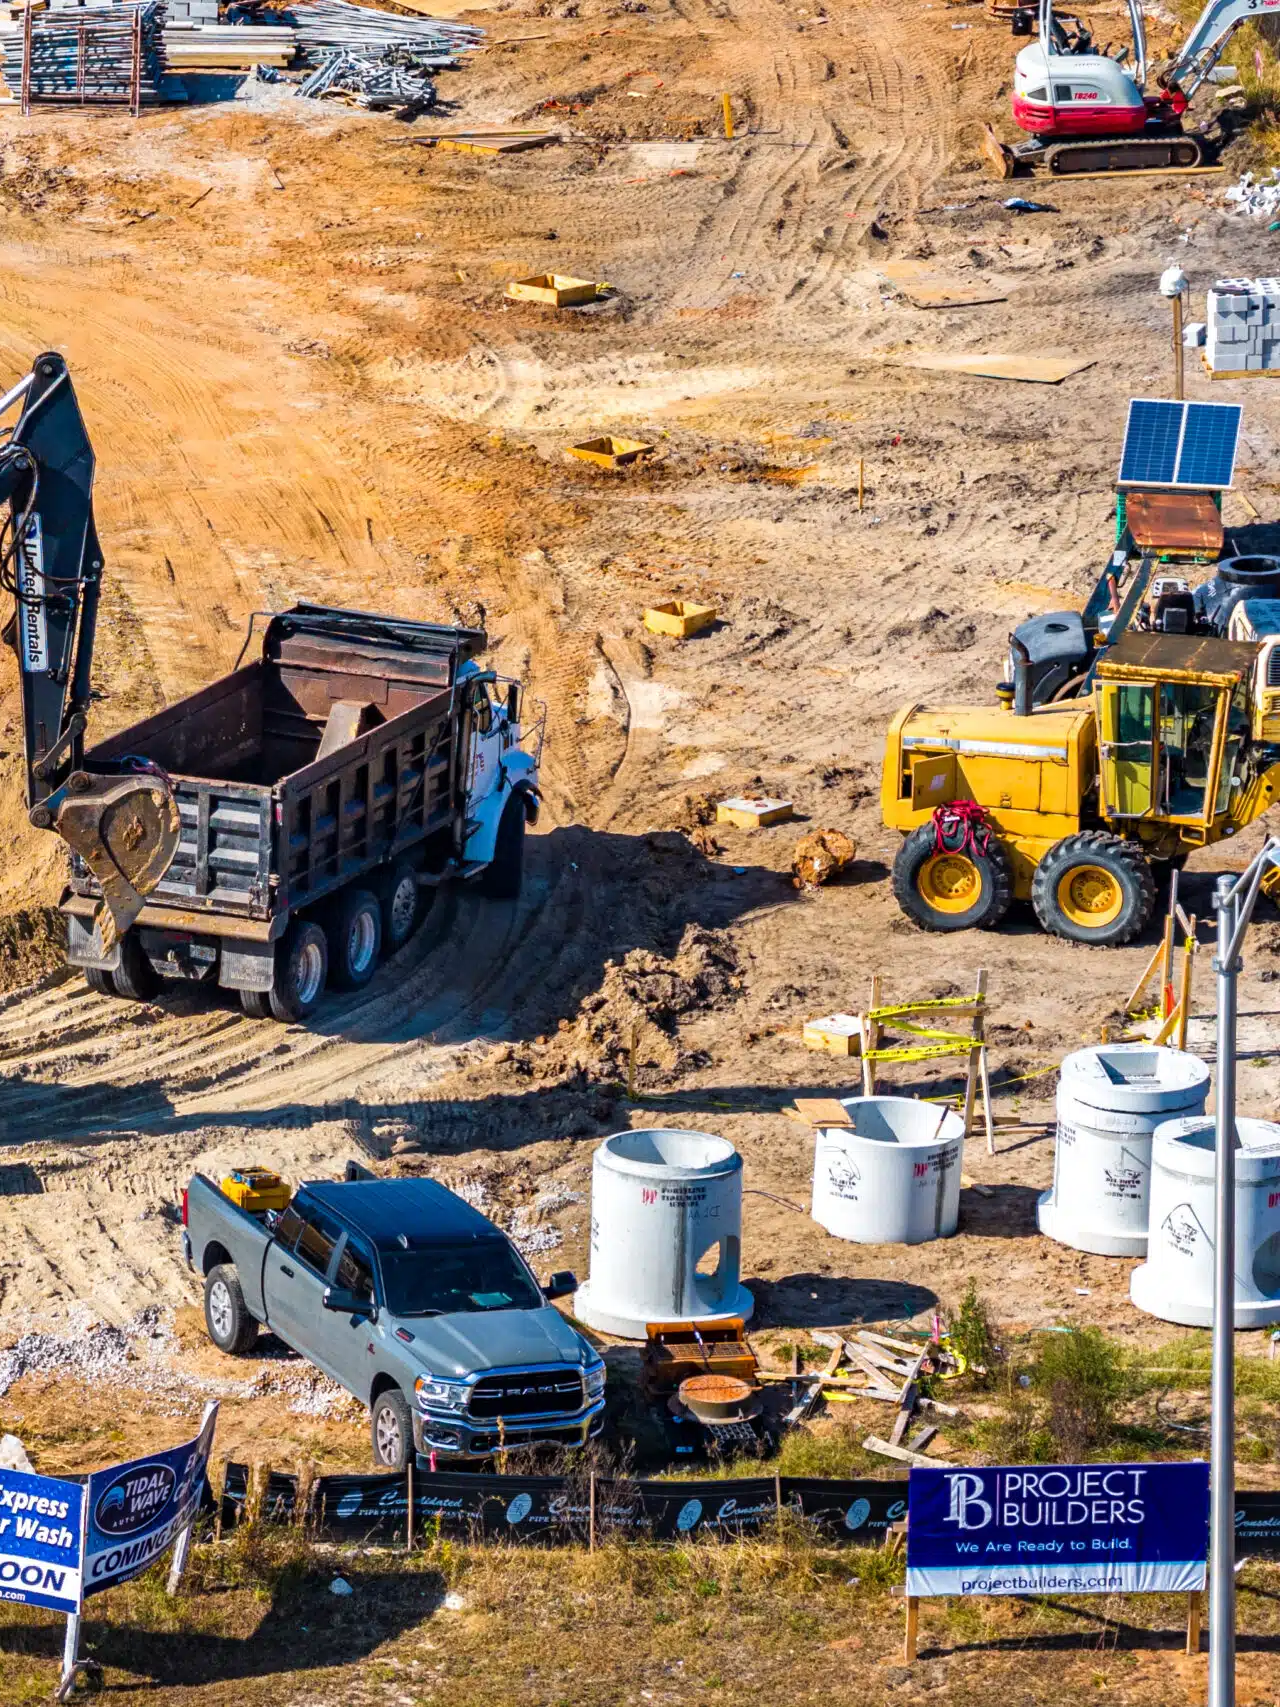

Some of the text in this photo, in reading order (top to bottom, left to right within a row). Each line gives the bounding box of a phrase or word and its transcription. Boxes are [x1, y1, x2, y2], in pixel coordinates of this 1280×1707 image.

[507, 1386, 553, 1396] RAM
[126, 1471, 166, 1498] TIDAL
[1005, 1470, 1148, 1498] PROJECT
[130, 1484, 171, 1513] WAVE
[113, 1516, 135, 1528] AUTO
[1003, 1500, 1146, 1526] BUILDERS
[15, 1517, 73, 1548] Wash
[955, 1538, 1132, 1553] We Are Ready to Build.
[92, 1530, 169, 1578] COMING
[962, 1575, 1123, 1592] projectbuilders.com
